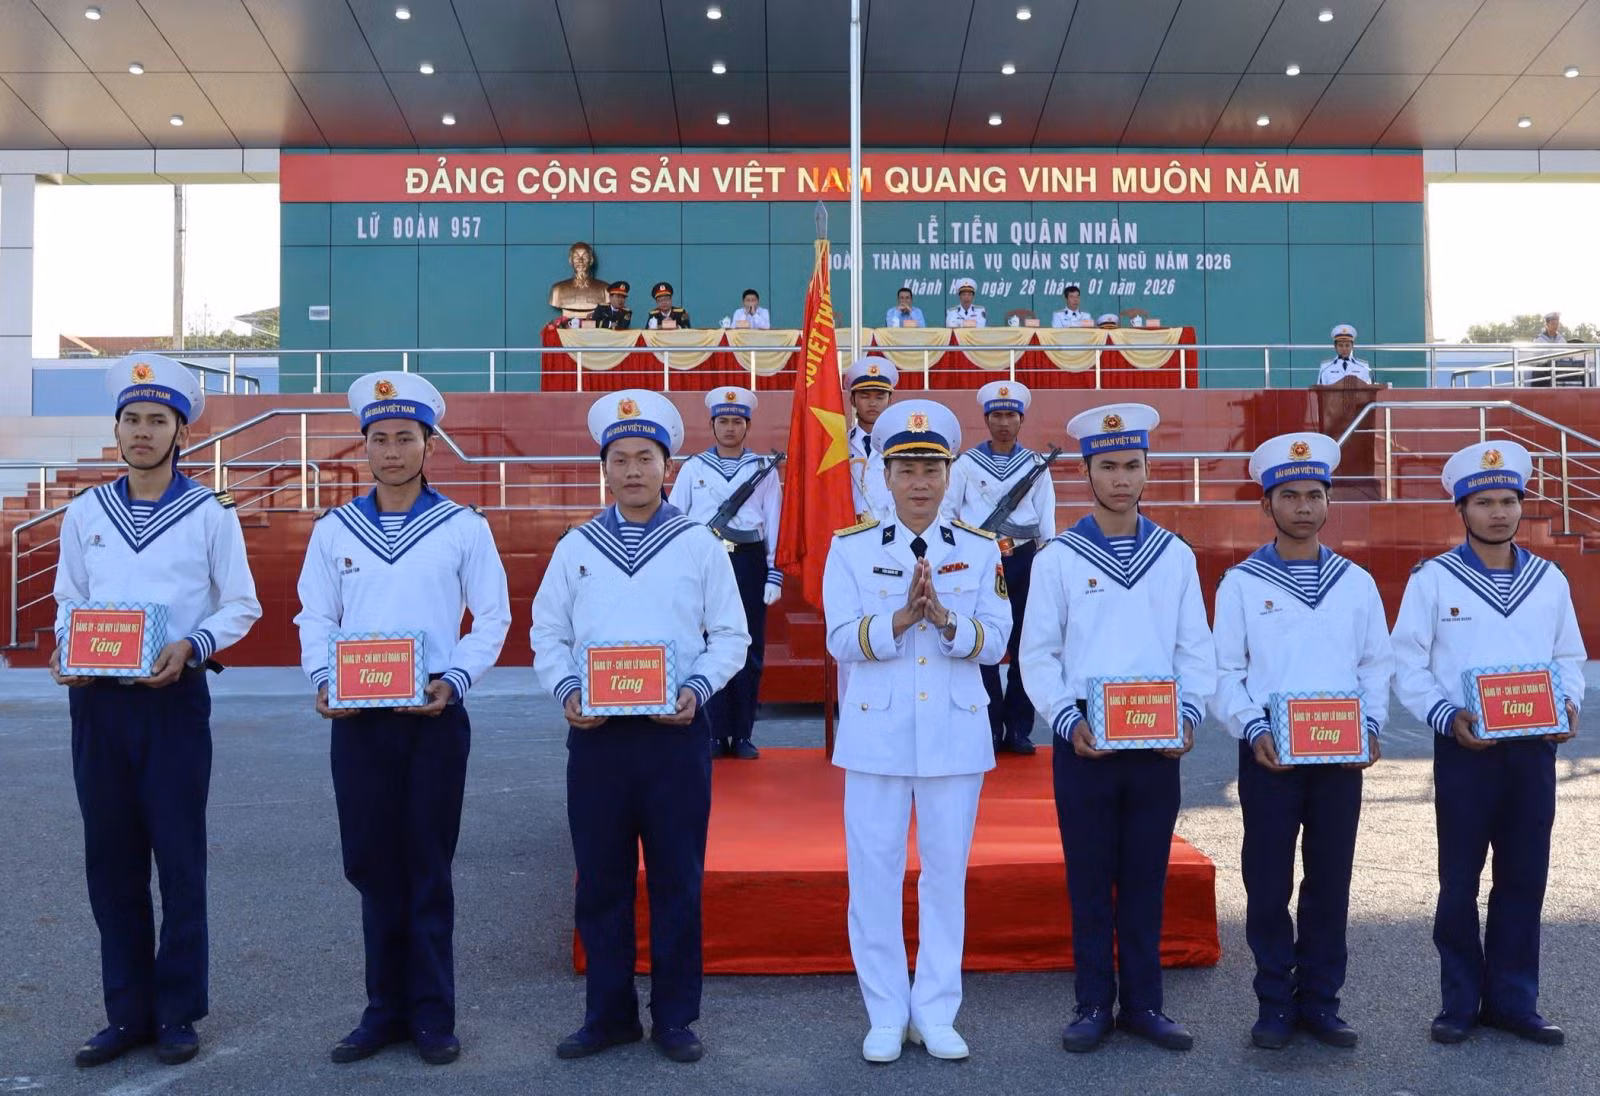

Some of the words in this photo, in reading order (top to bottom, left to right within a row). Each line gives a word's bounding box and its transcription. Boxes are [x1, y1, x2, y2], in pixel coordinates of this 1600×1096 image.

[405, 157, 504, 195] ĐẢNG
[517, 160, 617, 200] CỘNG
[629, 156, 700, 193] SẢN
[712, 160, 786, 199] VIỆT
[884, 166, 1007, 195] QUANG
[1018, 167, 1097, 193] VINH
[1112, 160, 1211, 194] MUÔN
[1226, 161, 1300, 194] NĂM
[357, 211, 380, 239] LỮ
[393, 212, 439, 239] ĐOÀN
[451, 216, 481, 239] 957
[918, 215, 939, 244] LỄ
[951, 215, 998, 244] TIỄN
[1010, 218, 1067, 246] QUÂN
[1079, 218, 1138, 244] NHÂN
[872, 251, 921, 270] THÀNH
[929, 250, 975, 270] NGHĨA
[984, 253, 1003, 273] VỤ
[1011, 251, 1052, 271] QUÂN
[1060, 251, 1080, 273] SỰ
[1086, 253, 1109, 273] TẠI
[1118, 251, 1147, 271] NGŨ
[1155, 251, 1189, 270] NĂM
[1196, 253, 1232, 270] 2026
[981, 278, 1012, 298] ngày
[1019, 278, 1036, 296] 28
[1088, 278, 1103, 296] 01
[1109, 278, 1136, 296] năm
[1143, 278, 1176, 296] 2026
[628, 423, 642, 432] VIỆT
[90, 637, 122, 657] Tặng
[359, 668, 393, 688] Tặng
[610, 675, 644, 694] Tặng
[1125, 710, 1156, 728] Tặng
[1502, 700, 1534, 718] Tặng
[1310, 726, 1340, 744] Tặng
